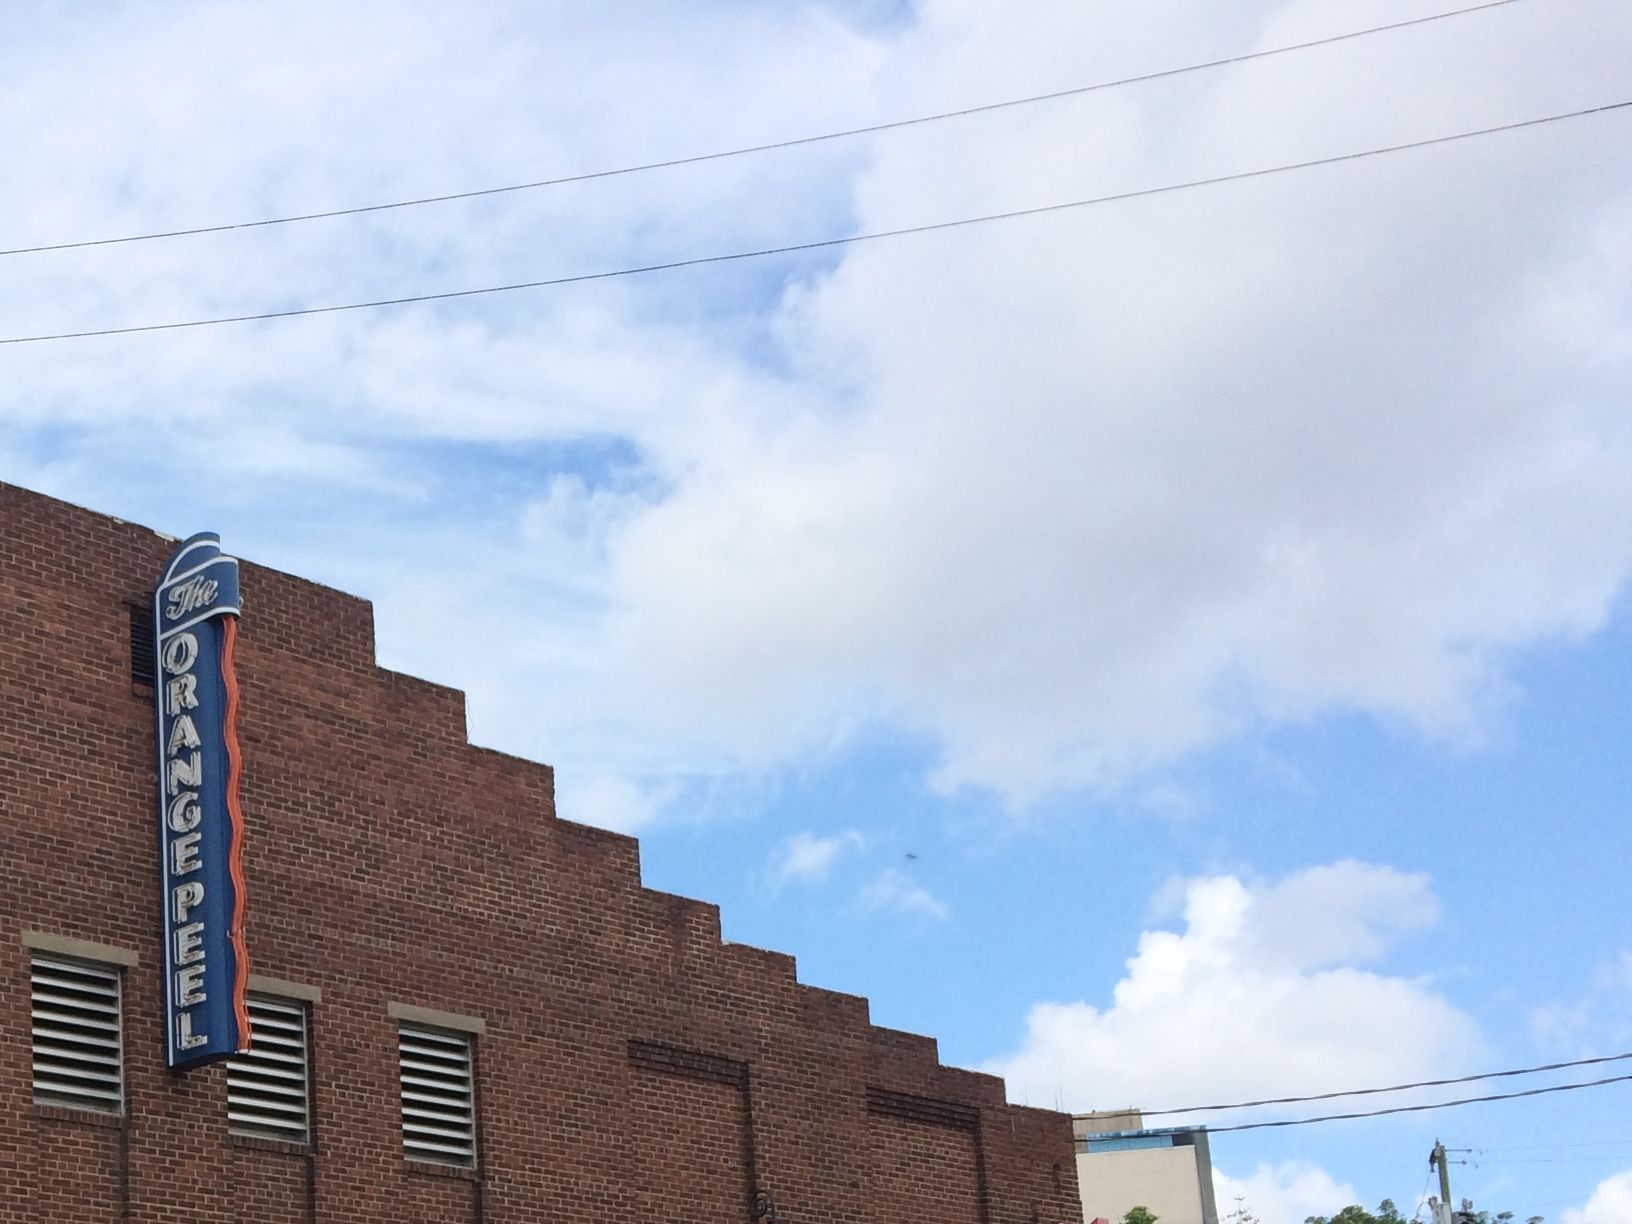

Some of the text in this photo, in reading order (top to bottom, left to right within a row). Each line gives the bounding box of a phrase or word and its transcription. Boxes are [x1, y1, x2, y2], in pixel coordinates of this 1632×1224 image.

[165, 575, 218, 621] The
[162, 632, 208, 1051] ORANGE PEEL
